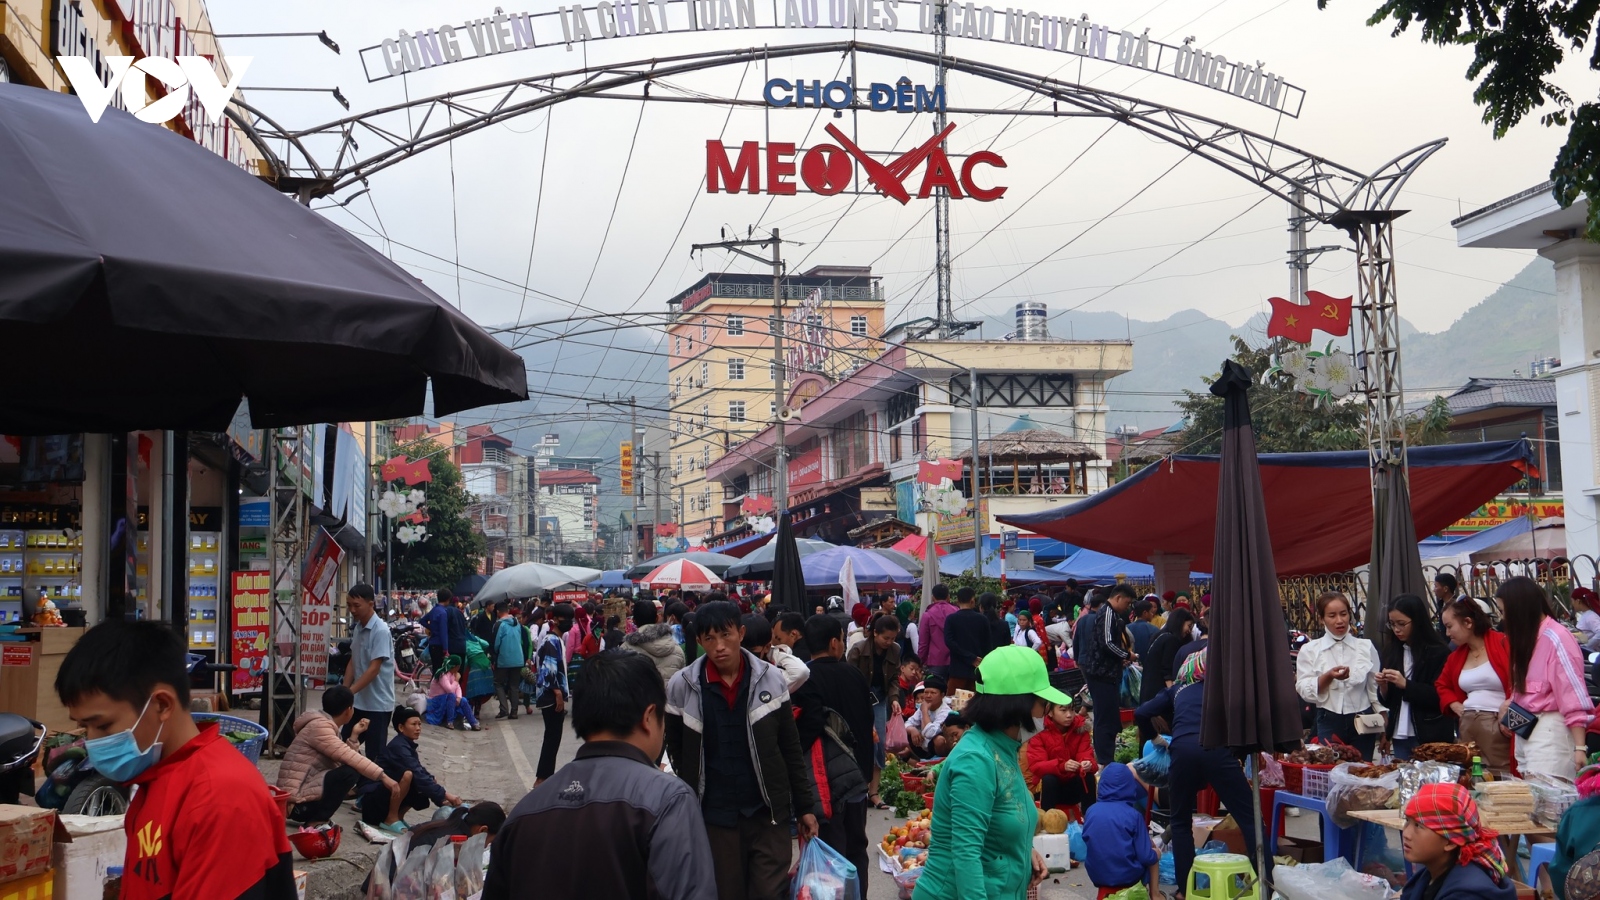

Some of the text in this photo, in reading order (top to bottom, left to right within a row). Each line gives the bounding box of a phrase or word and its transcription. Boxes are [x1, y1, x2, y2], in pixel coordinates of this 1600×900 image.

[381, 24, 463, 76] CÔNG
[464, 6, 535, 57] VIÊN
[949, 1, 995, 41] CAO
[1004, 7, 1109, 60] NGUYÊN
[1116, 27, 1151, 69] ĐÁ
[1232, 59, 1284, 109] VĂN
[763, 76, 947, 118] CHỢ ĐÊM
